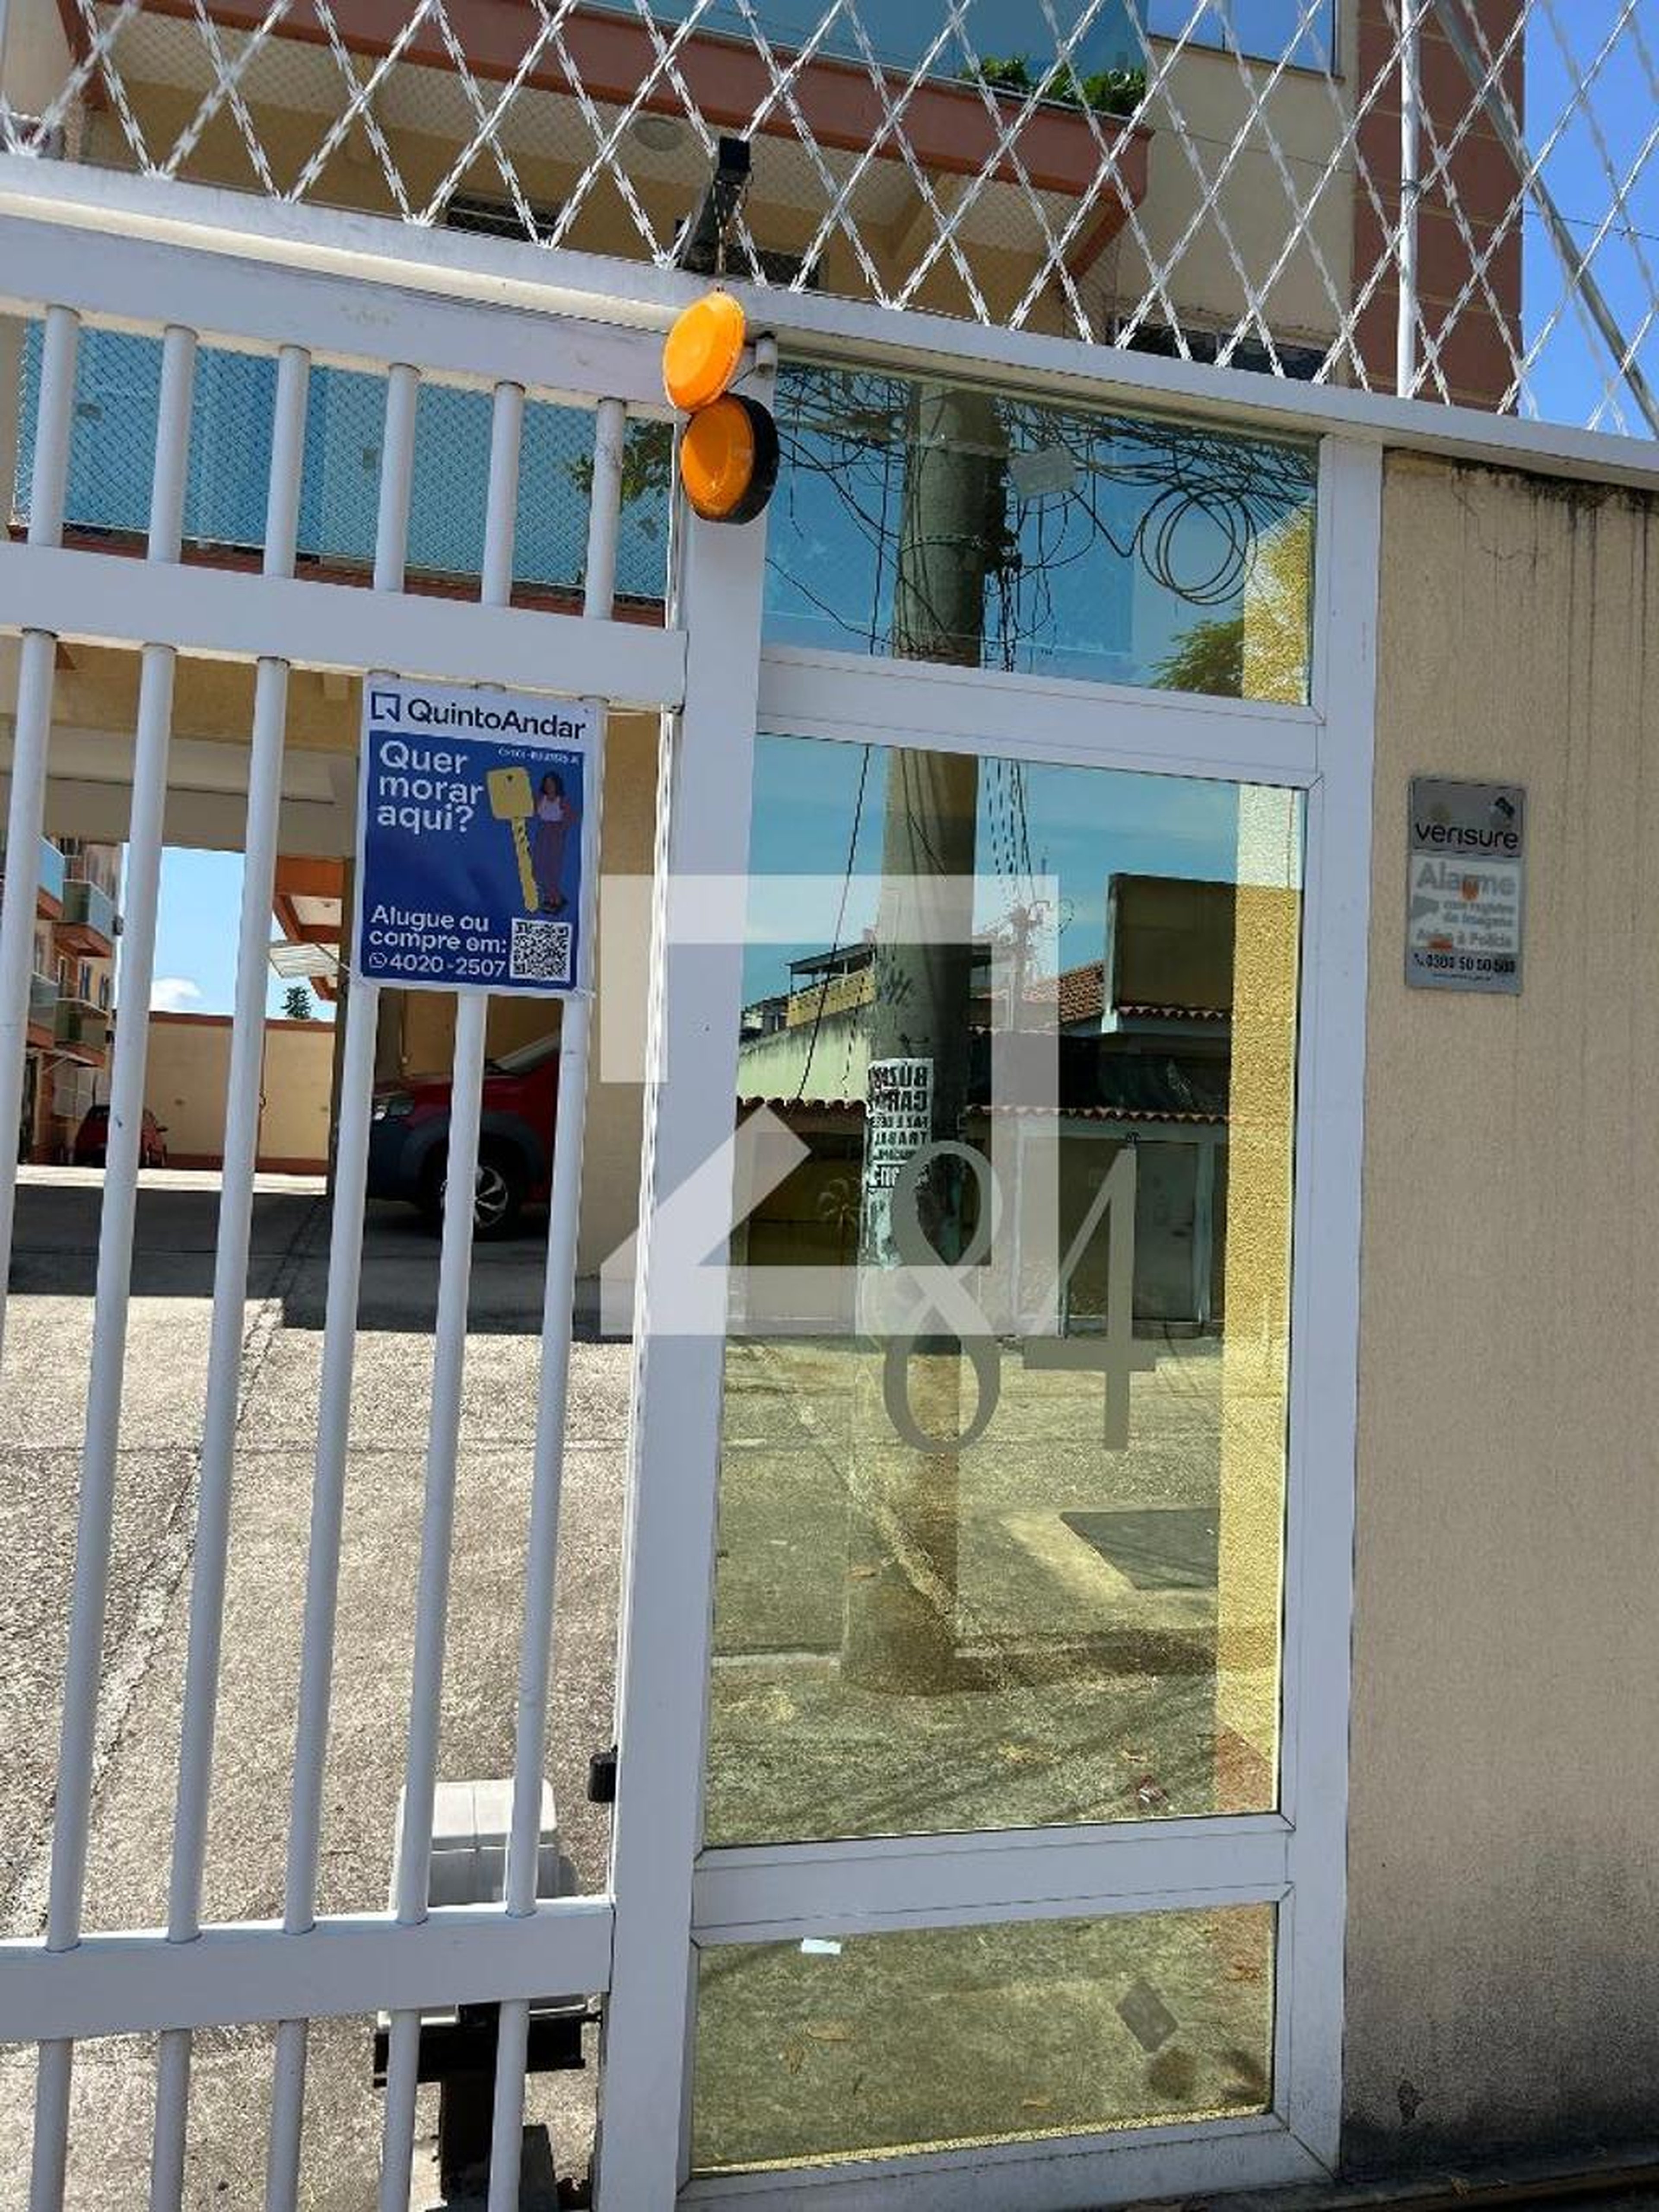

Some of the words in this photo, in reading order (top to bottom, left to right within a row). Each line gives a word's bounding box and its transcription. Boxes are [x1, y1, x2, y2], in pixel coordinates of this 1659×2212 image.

[407, 697, 586, 740] QuintoAndar
[379, 740, 468, 774] Quer
[378, 776, 484, 805] morar
[377, 804, 474, 834] aqui?
[1414, 823, 1518, 850] verisure
[370, 904, 454, 930] Alugue
[459, 916, 489, 932] ou
[369, 929, 461, 952] compre
[465, 935, 507, 954] em:
[883, 1139, 1157, 1453] 84
